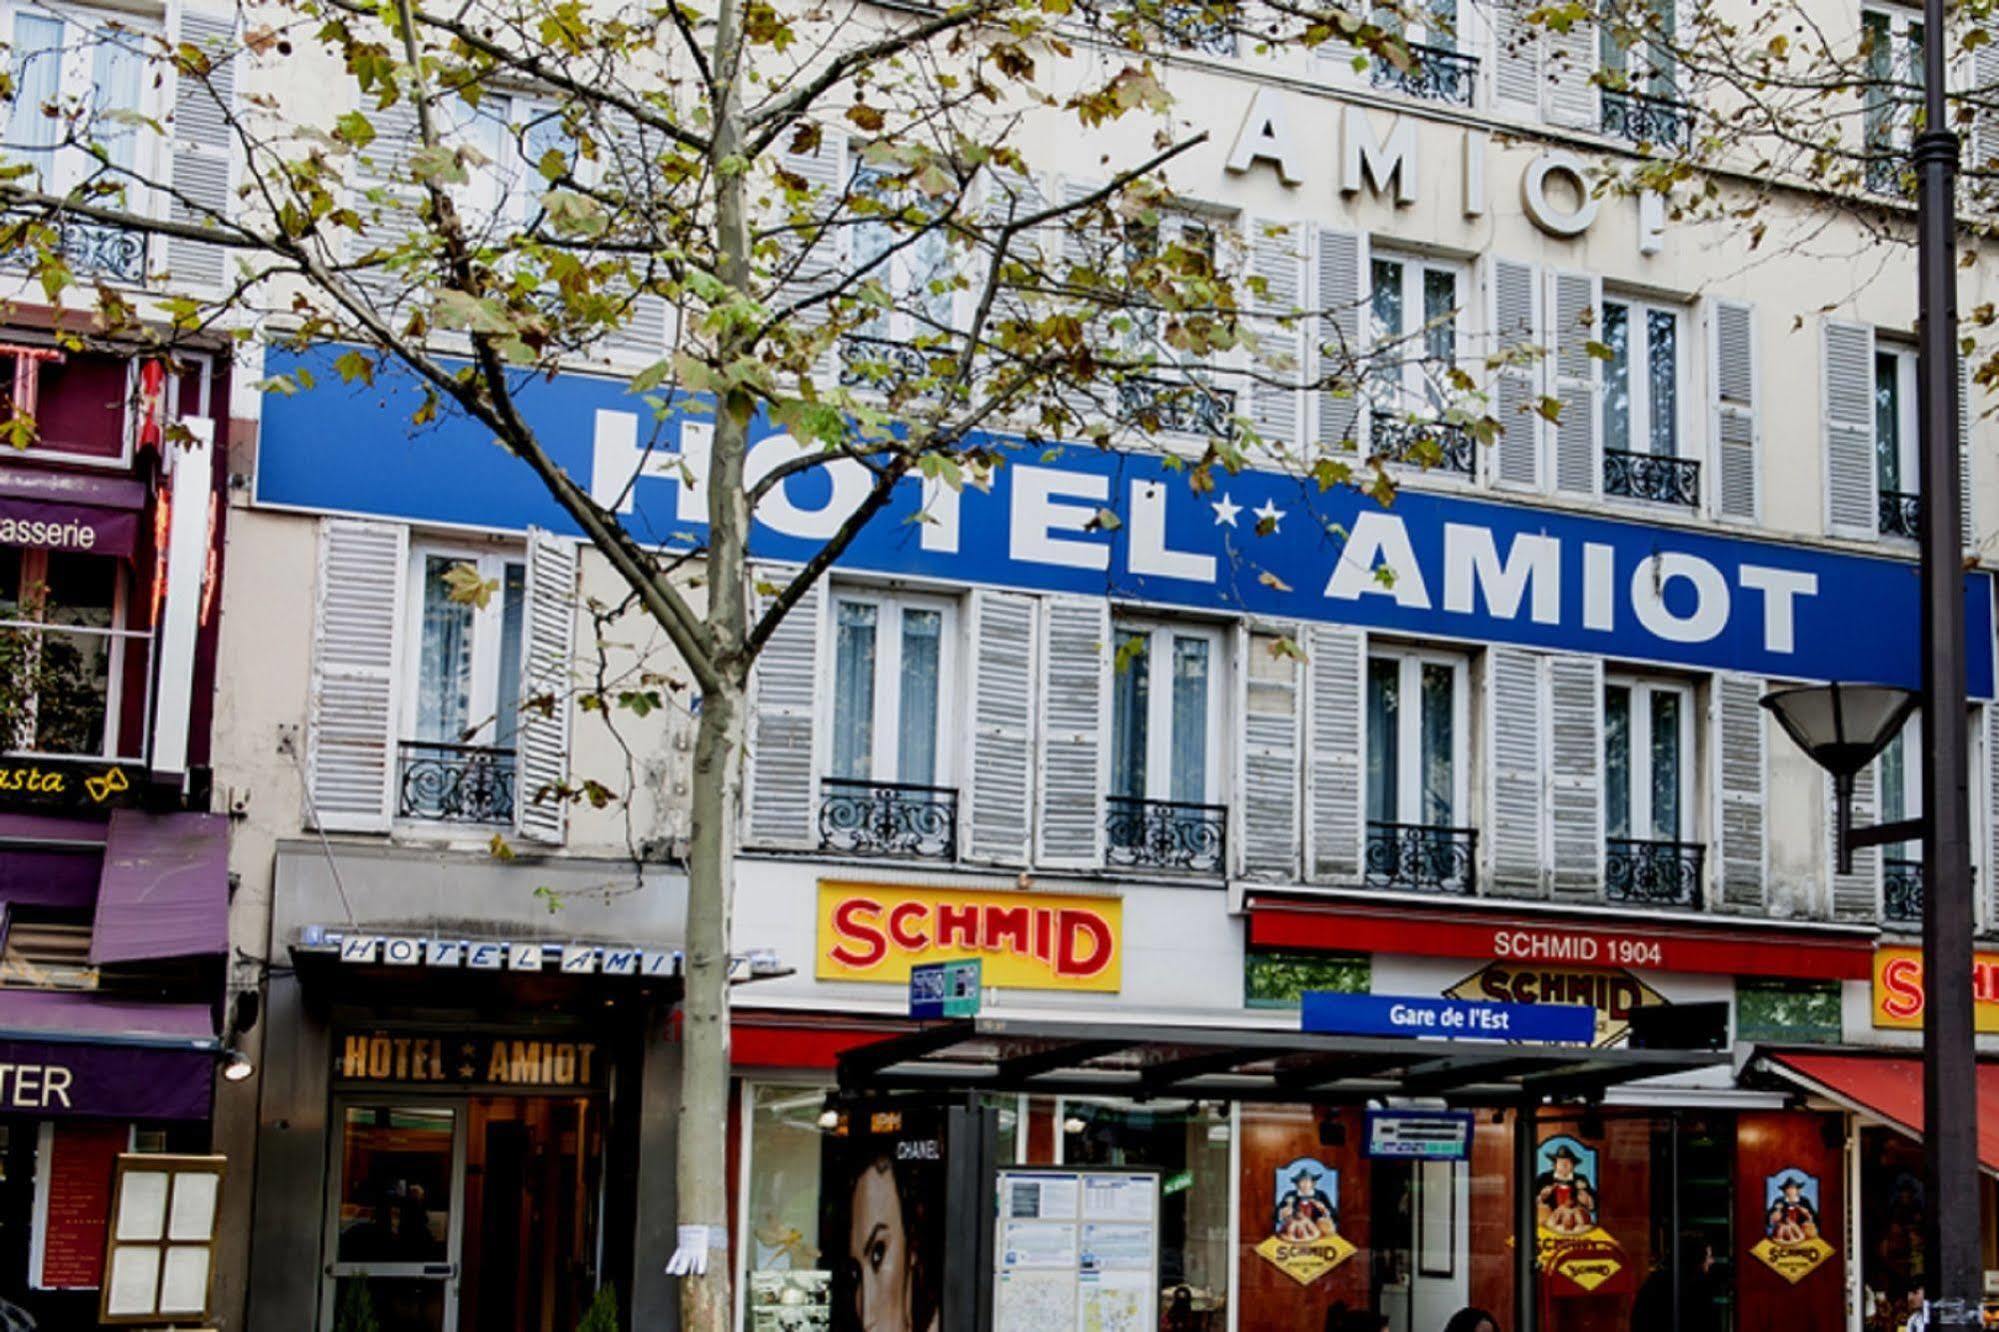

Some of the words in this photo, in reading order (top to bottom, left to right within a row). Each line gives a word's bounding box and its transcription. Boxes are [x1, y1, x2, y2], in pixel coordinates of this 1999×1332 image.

[592, 408, 1217, 583] HOTEL
[1323, 509, 1819, 654] AMIOT
[343, 938, 538, 969] HOTEL
[563, 946, 746, 975] AMIT
[828, 896, 1114, 979] SCHMID
[1493, 931, 1598, 961] SCHMID
[1607, 940, 1662, 965] 1904
[1390, 1004, 1436, 1027] Gare
[1440, 1006, 1465, 1028] de
[1469, 1008, 1510, 1030] l'Est
[1479, 969, 1643, 1021] SCHMID
[343, 1030, 446, 1080] HÔTEL
[487, 1040, 596, 1084] AMIOT
[897, 1139, 940, 1160] CHANEL
